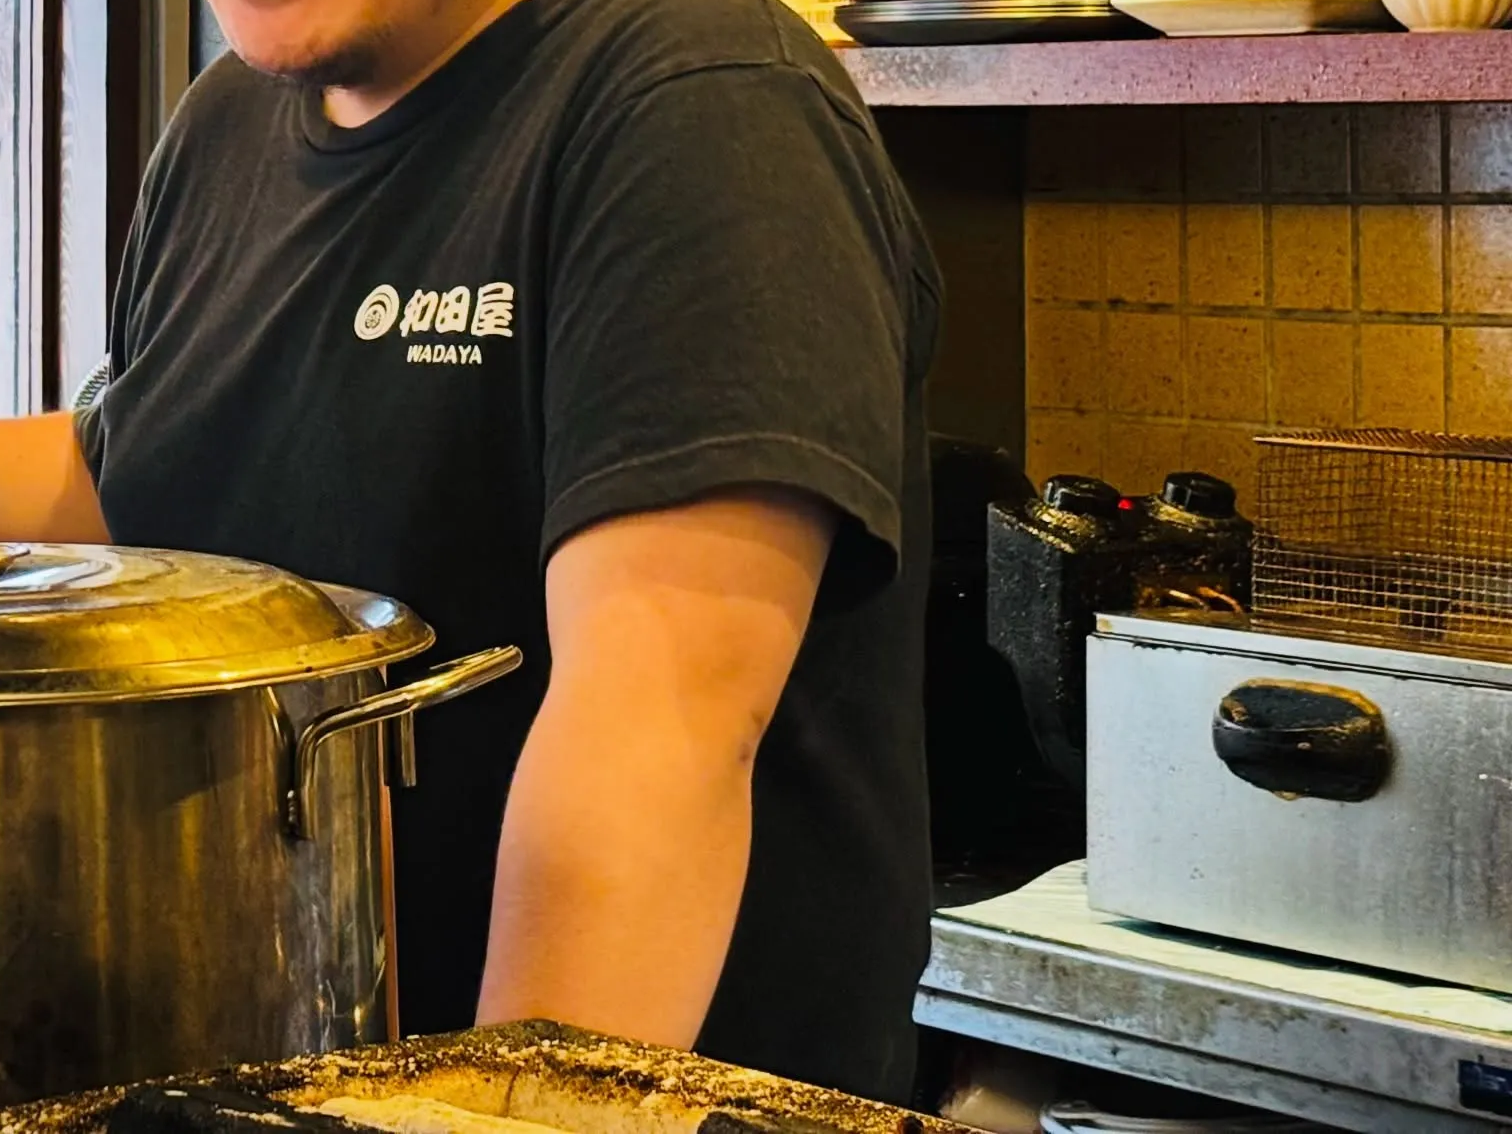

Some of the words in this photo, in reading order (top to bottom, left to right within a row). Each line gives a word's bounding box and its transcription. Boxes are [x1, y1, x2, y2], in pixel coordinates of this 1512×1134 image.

[399, 282, 514, 338] 和田屋
[406, 344, 483, 365] WADAYA
